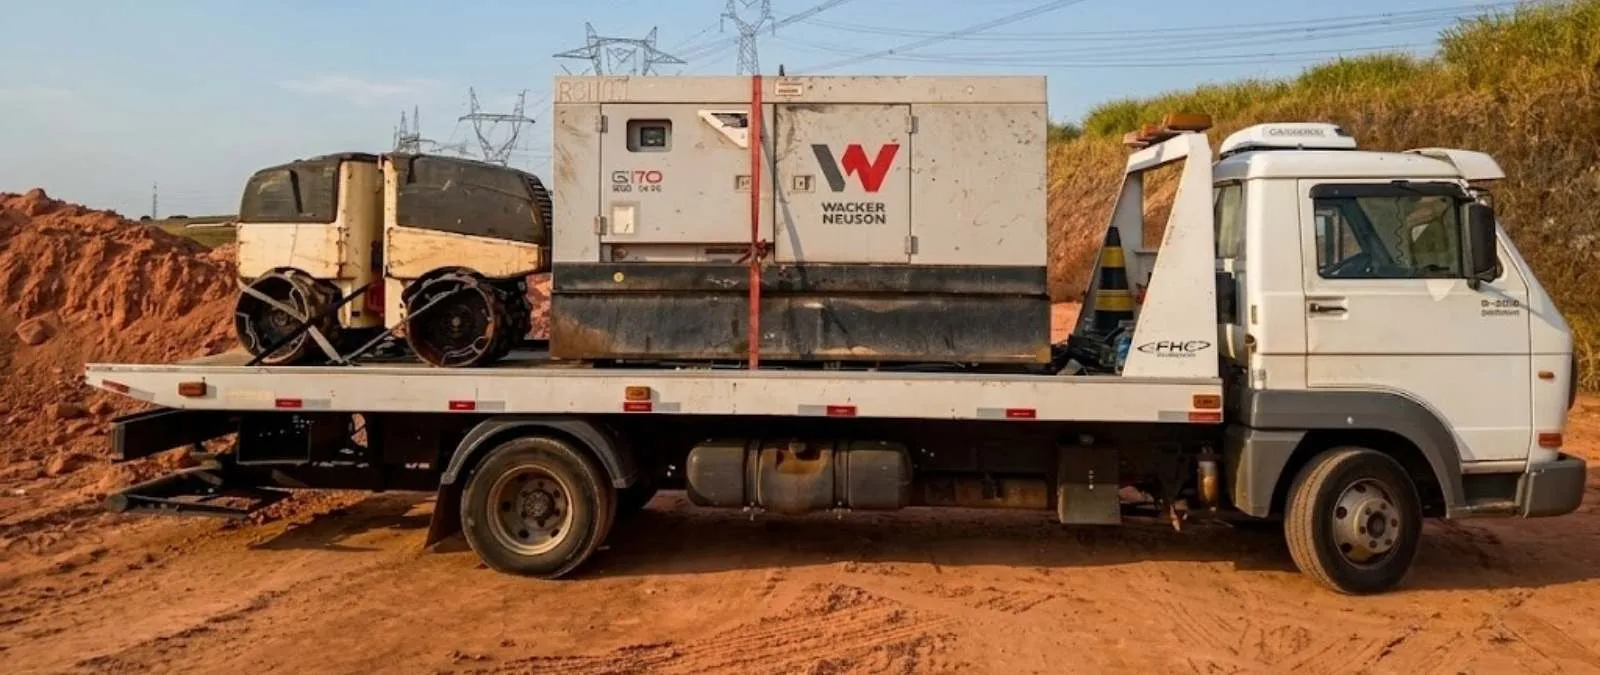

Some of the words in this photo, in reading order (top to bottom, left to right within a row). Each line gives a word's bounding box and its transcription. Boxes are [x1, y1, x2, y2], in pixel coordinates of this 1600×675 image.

[611, 170, 663, 184] G170
[821, 202, 886, 213] WACKER
[822, 214, 886, 224] NEUSON
